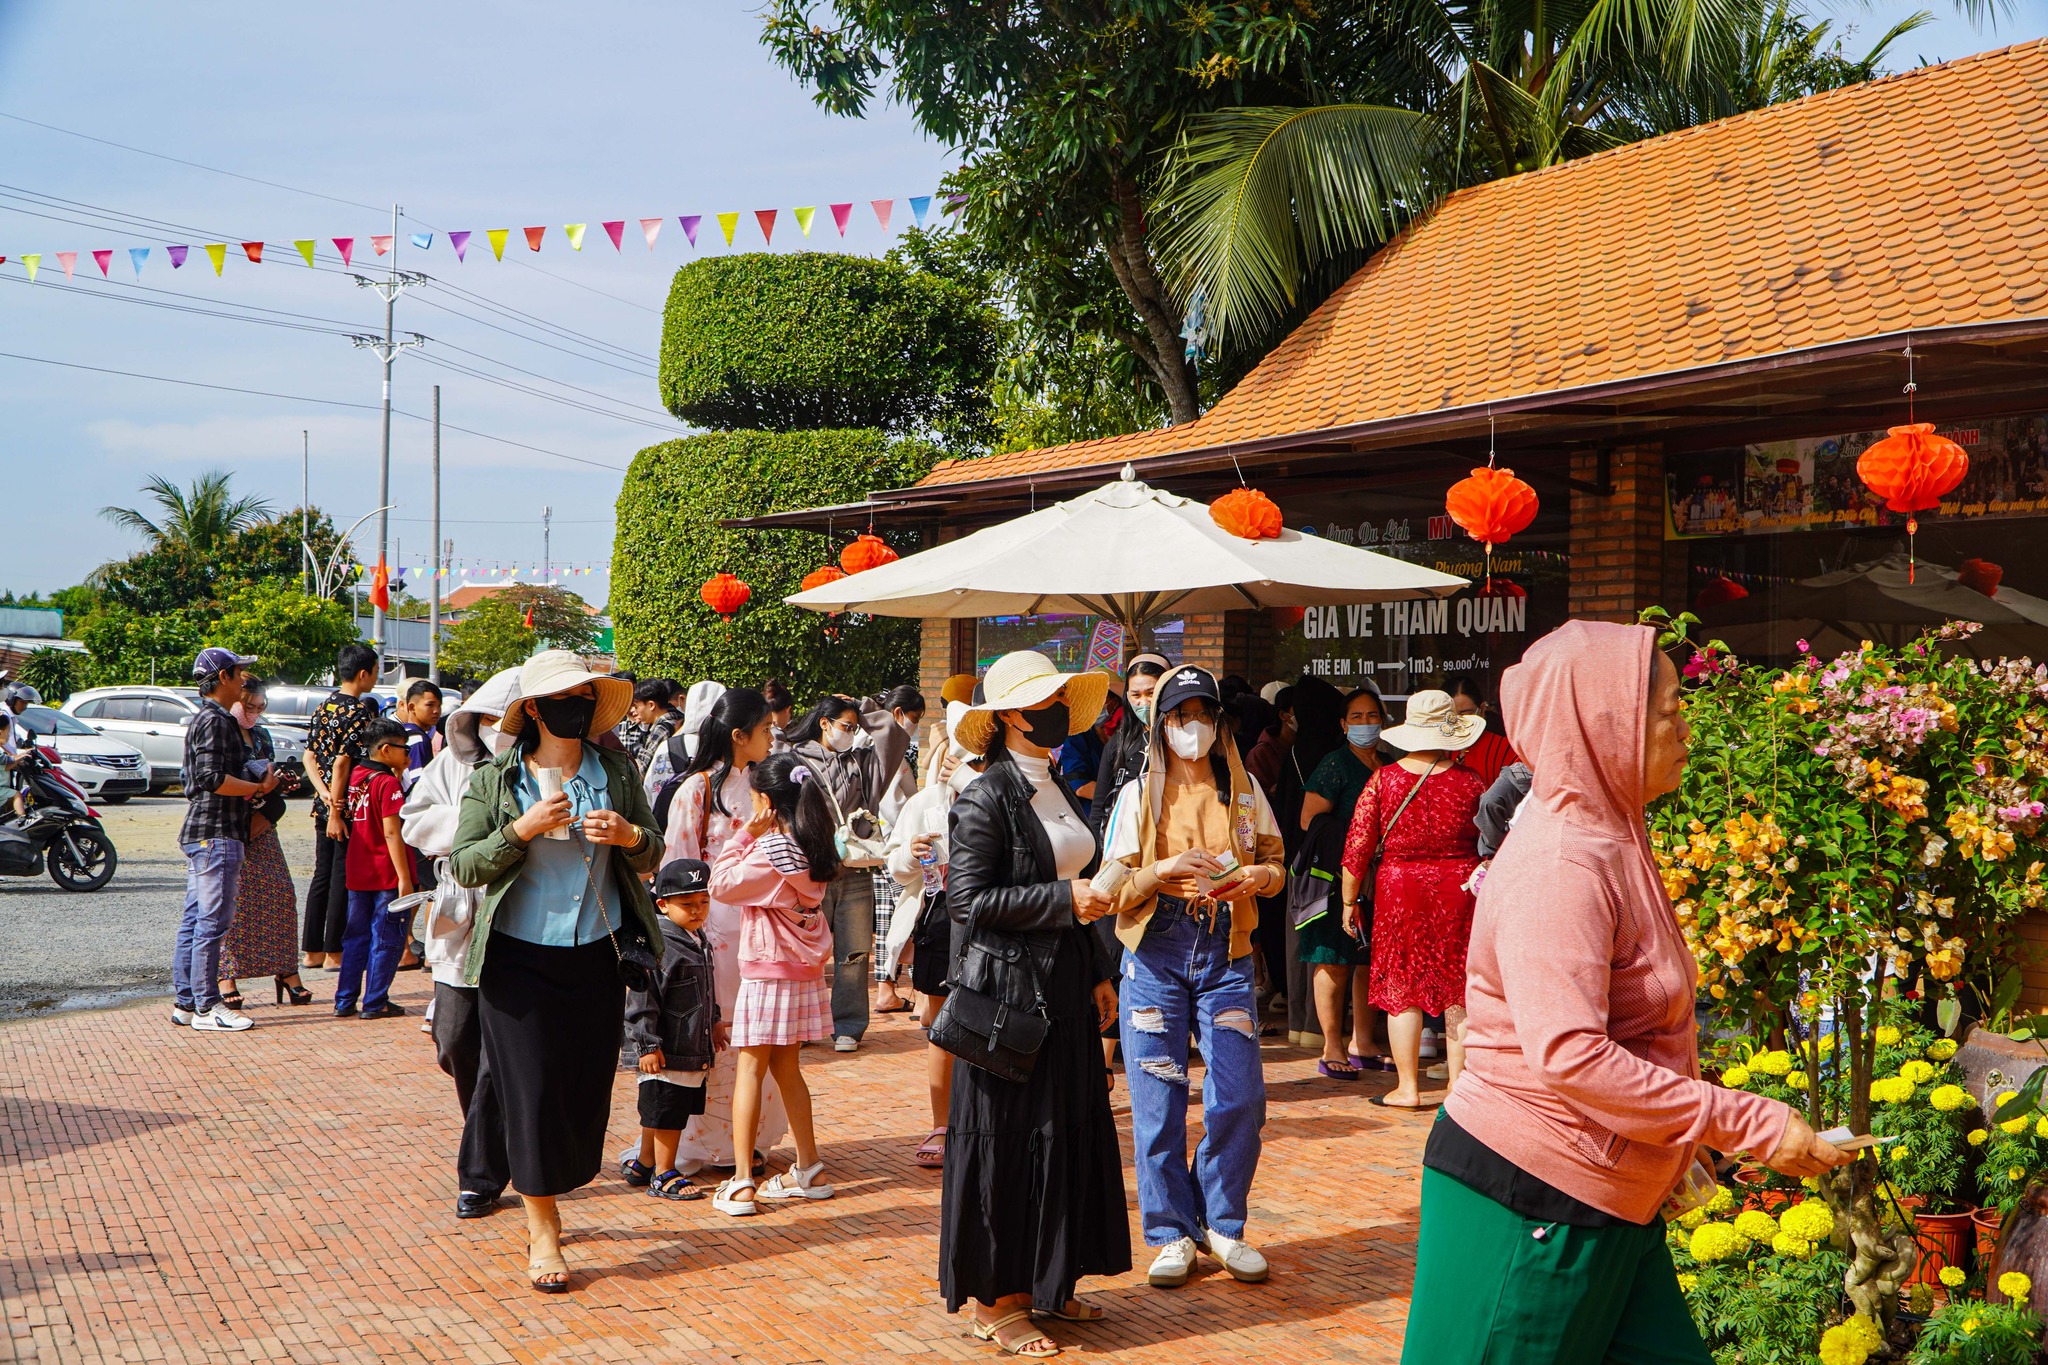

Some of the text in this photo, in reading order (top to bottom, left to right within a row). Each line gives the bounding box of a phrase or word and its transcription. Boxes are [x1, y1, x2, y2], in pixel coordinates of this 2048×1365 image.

[1358, 521, 1379, 545] Du
[1382, 518, 1411, 546] Lịch
[1489, 556, 1522, 573] Nam
[1381, 599, 1448, 636] THAM
[1456, 595, 1526, 638] QUAN
[1408, 656, 1433, 674] 1m3
[1178, 679, 1201, 687] adidas
